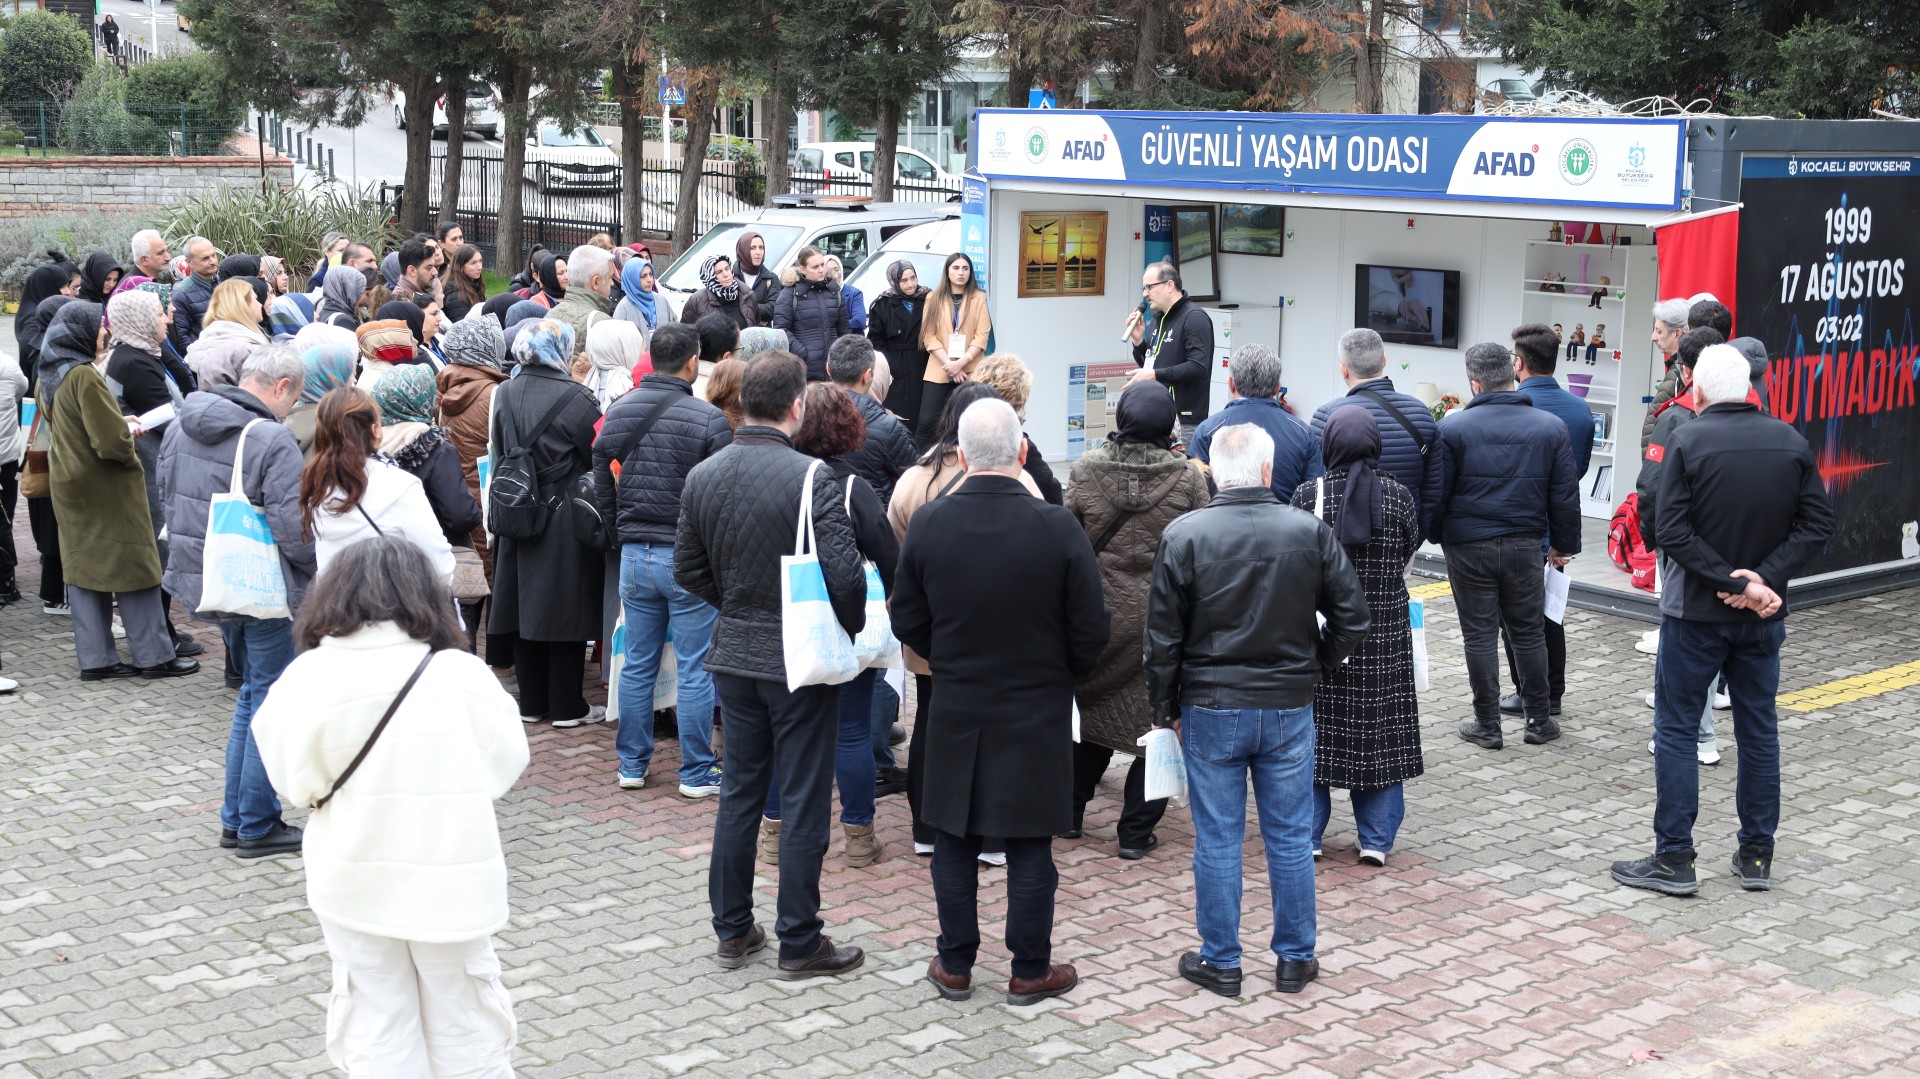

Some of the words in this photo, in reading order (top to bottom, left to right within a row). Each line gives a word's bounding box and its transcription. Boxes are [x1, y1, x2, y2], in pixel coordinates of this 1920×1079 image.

[1062, 140, 1105, 161] AFAD
[1141, 124, 1243, 168] GÜVENLİ
[1250, 133, 1337, 178] YAŞAM
[1347, 135, 1428, 174] ODASI
[1473, 151, 1535, 177] AFAD
[1825, 206, 1872, 245] 1999
[1780, 264, 1801, 304] 17
[1804, 252, 1905, 301] AĞUSTOS
[1815, 314, 1863, 343] 03:02
[1763, 345, 1920, 425] NUTMADIK
